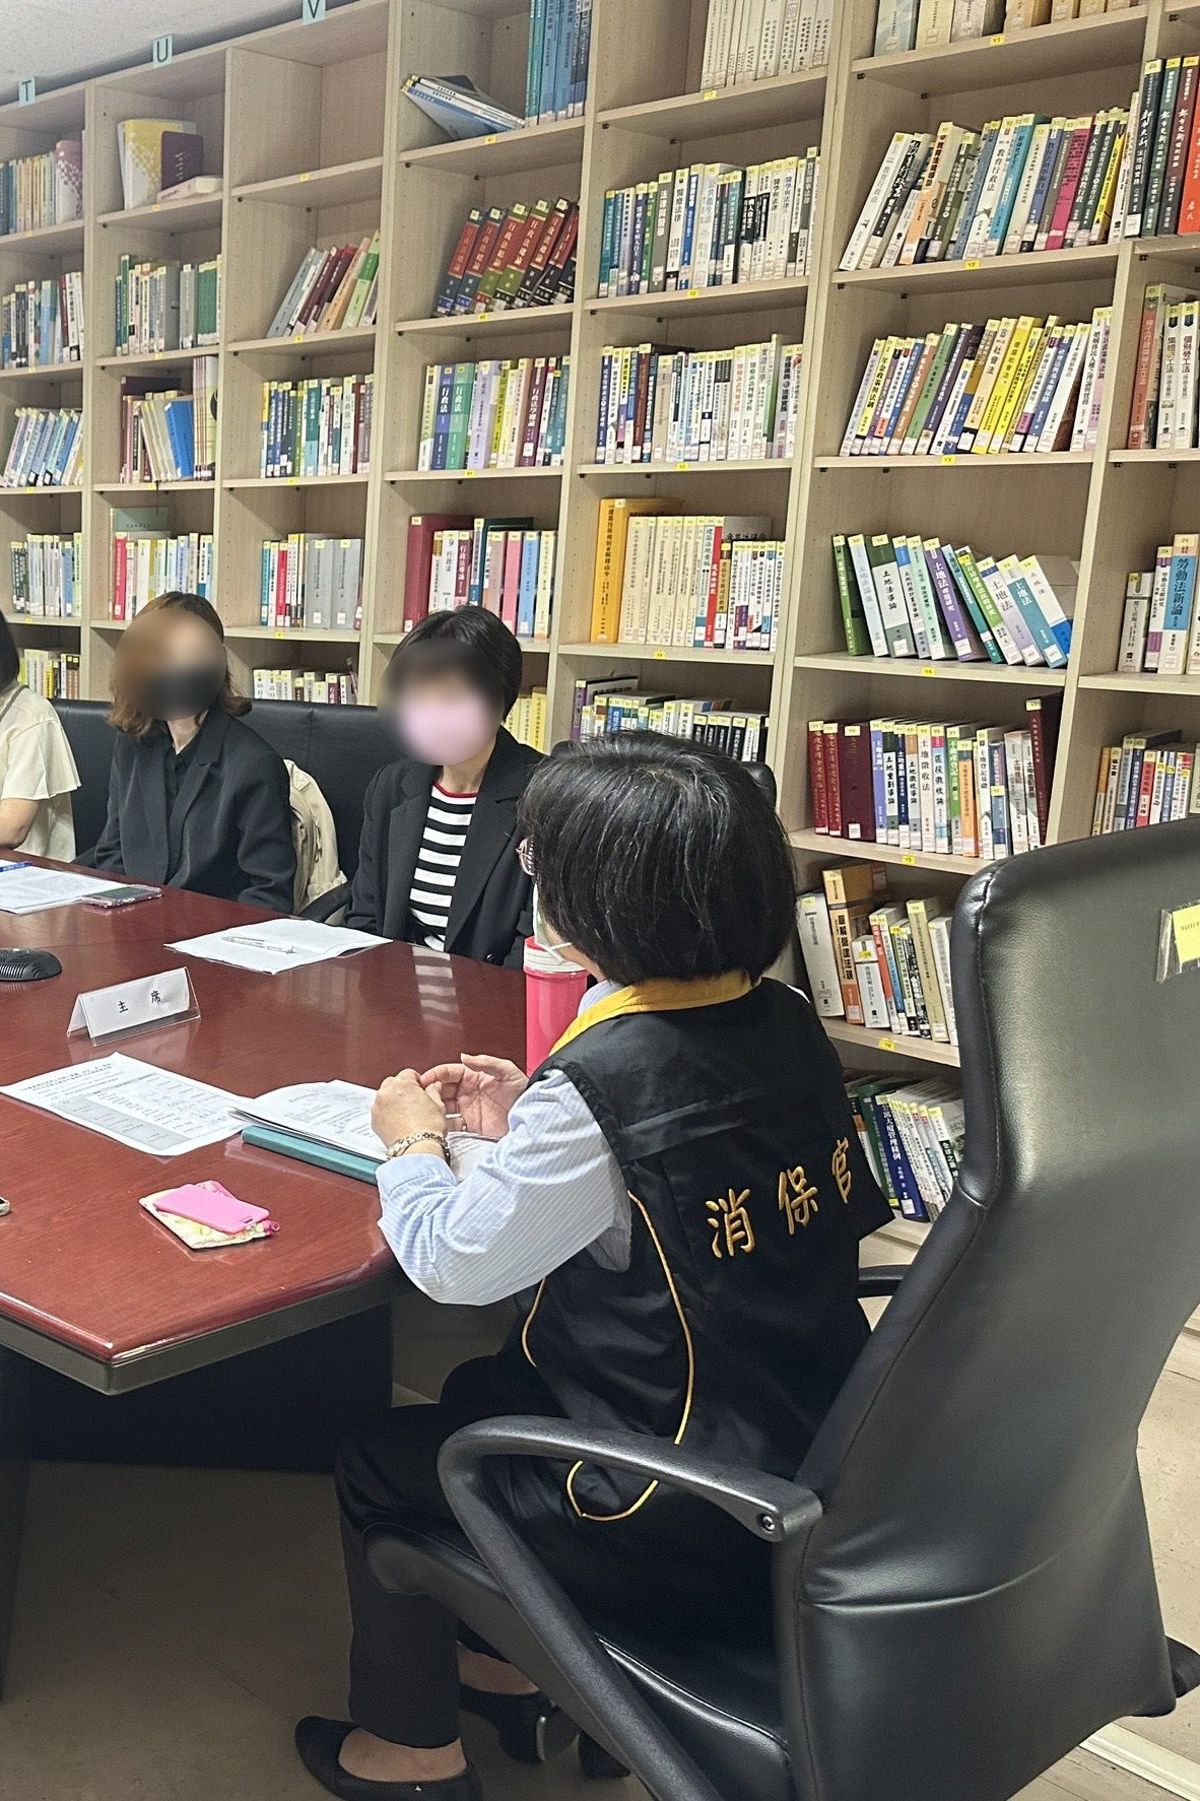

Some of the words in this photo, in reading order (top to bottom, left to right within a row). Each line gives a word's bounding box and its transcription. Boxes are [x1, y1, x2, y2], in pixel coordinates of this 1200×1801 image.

[308, 0, 321, 19] V
[156, 38, 169, 63] U
[21, 80, 32, 102] T
[440, 387, 450, 413] 行政法
[454, 386, 463, 412] 行政法
[993, 581, 1014, 611] 土地法
[1015, 582, 1032, 606] 土地法
[1171, 558, 1189, 616] 勞動法新論
[921, 739, 931, 791] 土地徵收法
[705, 1137, 851, 1259] 消保官
